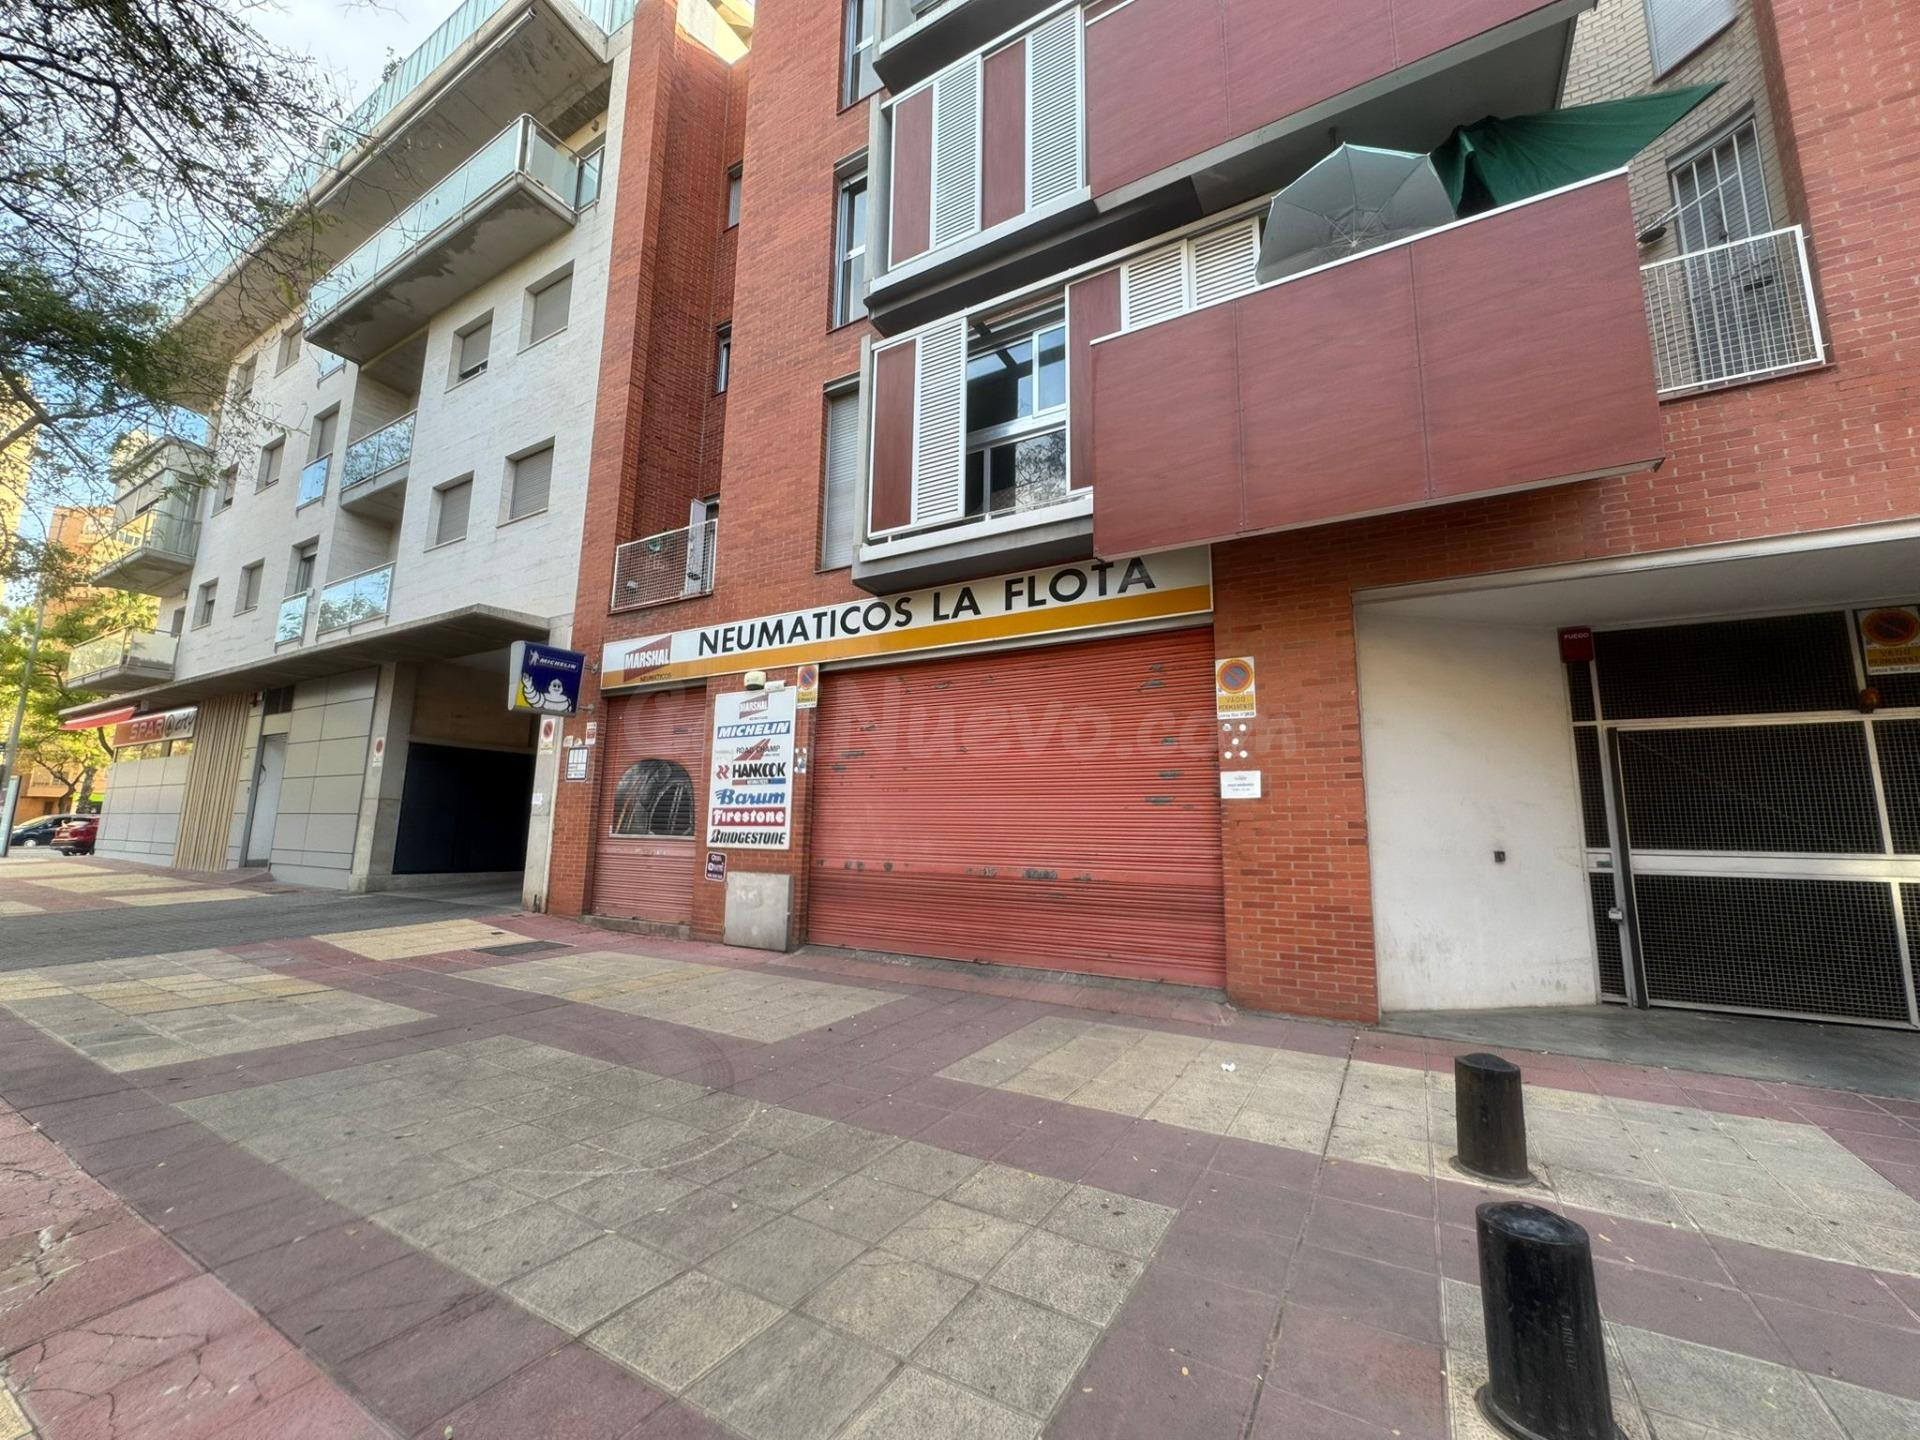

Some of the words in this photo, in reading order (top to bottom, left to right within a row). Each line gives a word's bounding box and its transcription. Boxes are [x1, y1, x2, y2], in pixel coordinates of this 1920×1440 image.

[699, 597, 913, 656] NEUMATICOS
[932, 587, 981, 621] LA
[1005, 557, 1156, 611] FLOTA
[539, 658, 577, 671] MICHELIN
[624, 648, 671, 669] MARSHAL
[130, 719, 164, 739] SPAR
[718, 722, 789, 738] MICHELIN
[716, 789, 785, 805] Barum
[713, 809, 784, 825] Firestone
[711, 829, 786, 845] BRIDGESTONE
